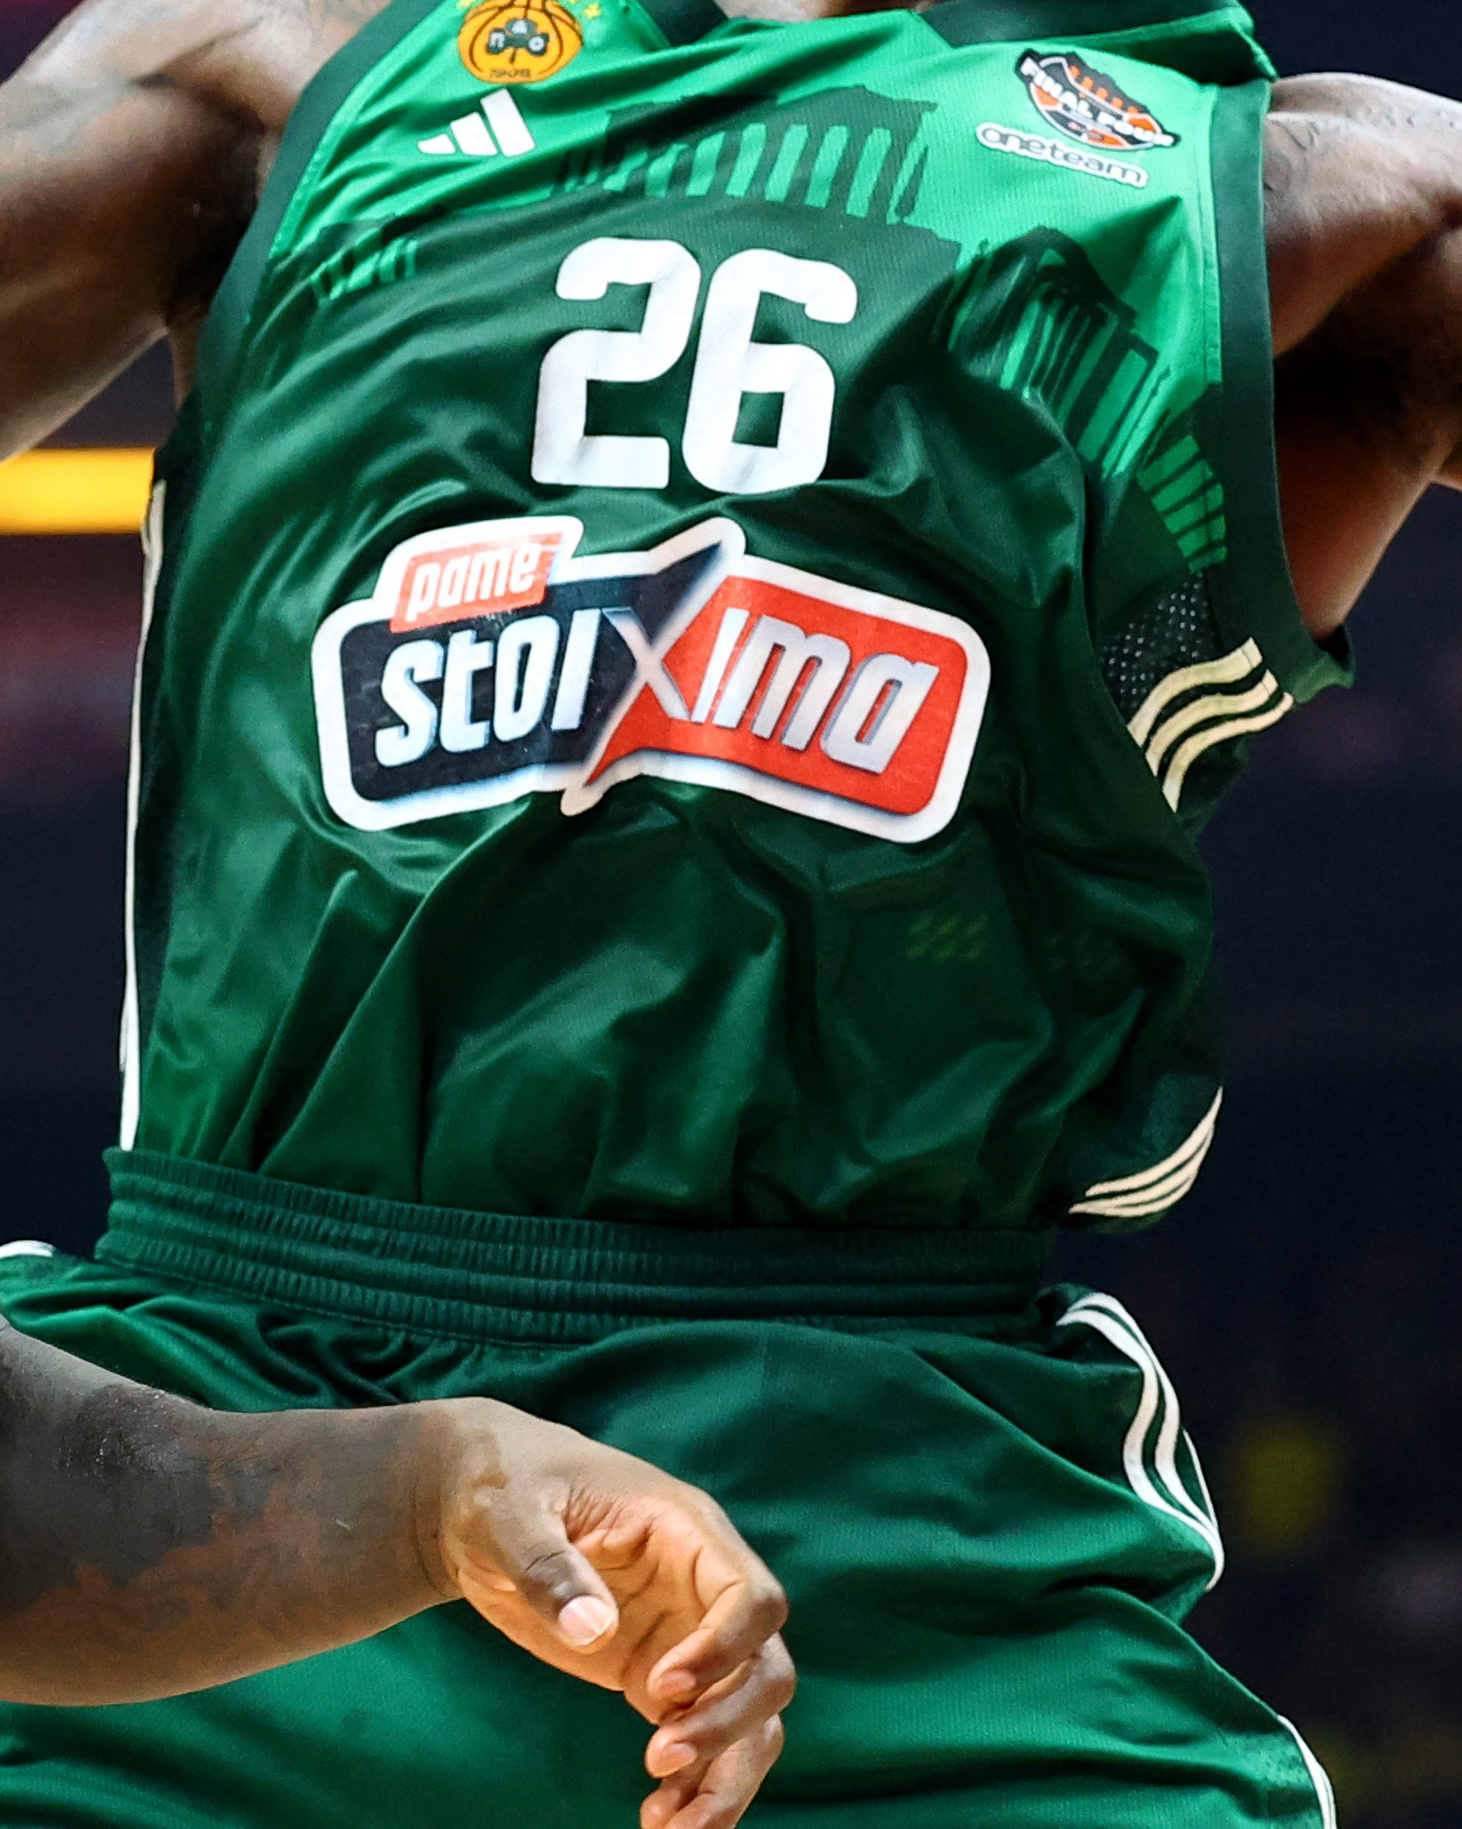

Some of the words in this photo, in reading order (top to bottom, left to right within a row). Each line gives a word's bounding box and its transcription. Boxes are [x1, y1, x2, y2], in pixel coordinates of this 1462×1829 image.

[1020, 56, 1094, 118] FINAL
[981, 127, 1142, 183] oneteam
[531, 236, 859, 495] 26
[408, 541, 542, 617] pame
